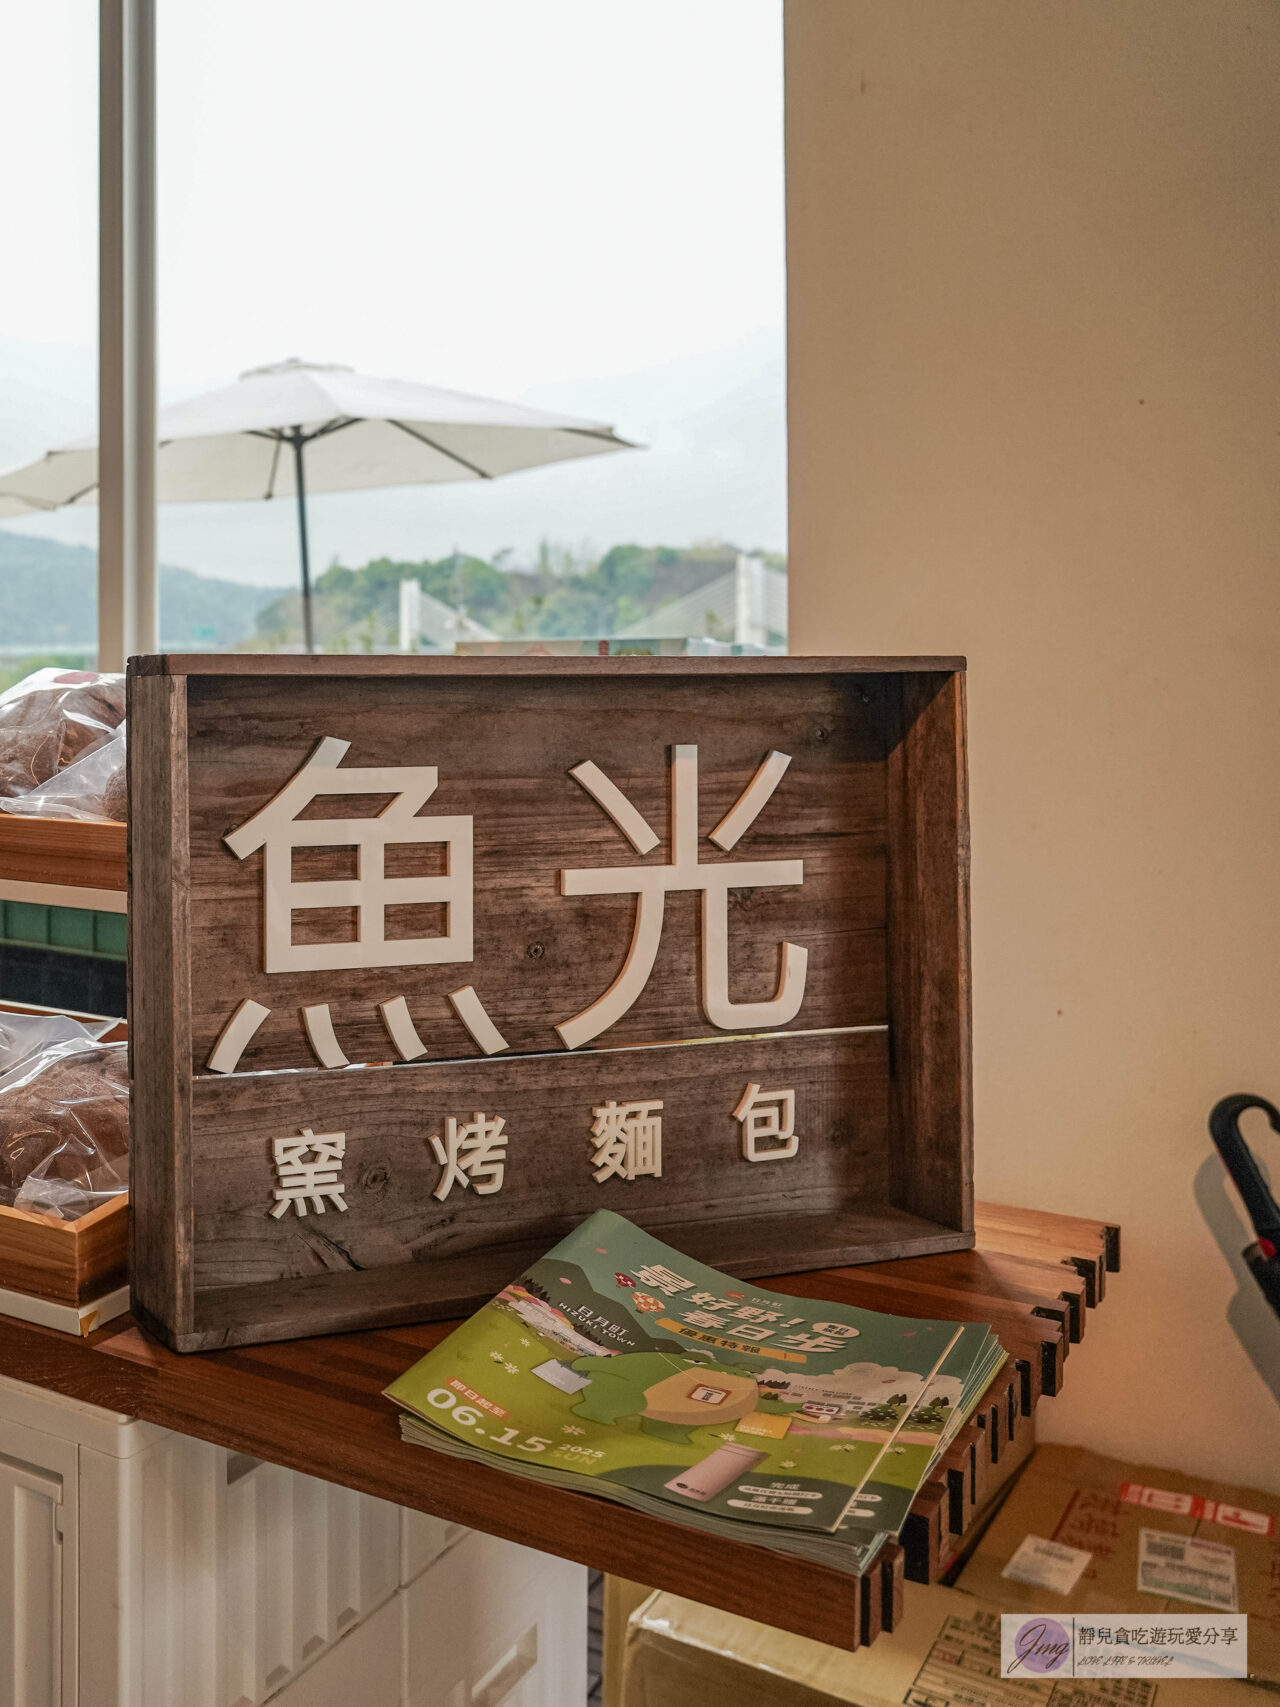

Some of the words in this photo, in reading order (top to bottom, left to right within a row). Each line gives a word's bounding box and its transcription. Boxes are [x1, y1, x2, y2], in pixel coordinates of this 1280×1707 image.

[208, 736, 808, 1074] 魚光
[269, 1082, 800, 1218] 窯烤麵包
[559, 1302, 598, 1329] HIZUKI
[602, 1328, 636, 1346] TOWN
[577, 1305, 629, 1336] 日月町
[677, 1327, 761, 1354] 優惠特報
[426, 1388, 552, 1452] 06.15
[550, 1450, 598, 1465] SUN
[557, 1443, 606, 1459] 2025
